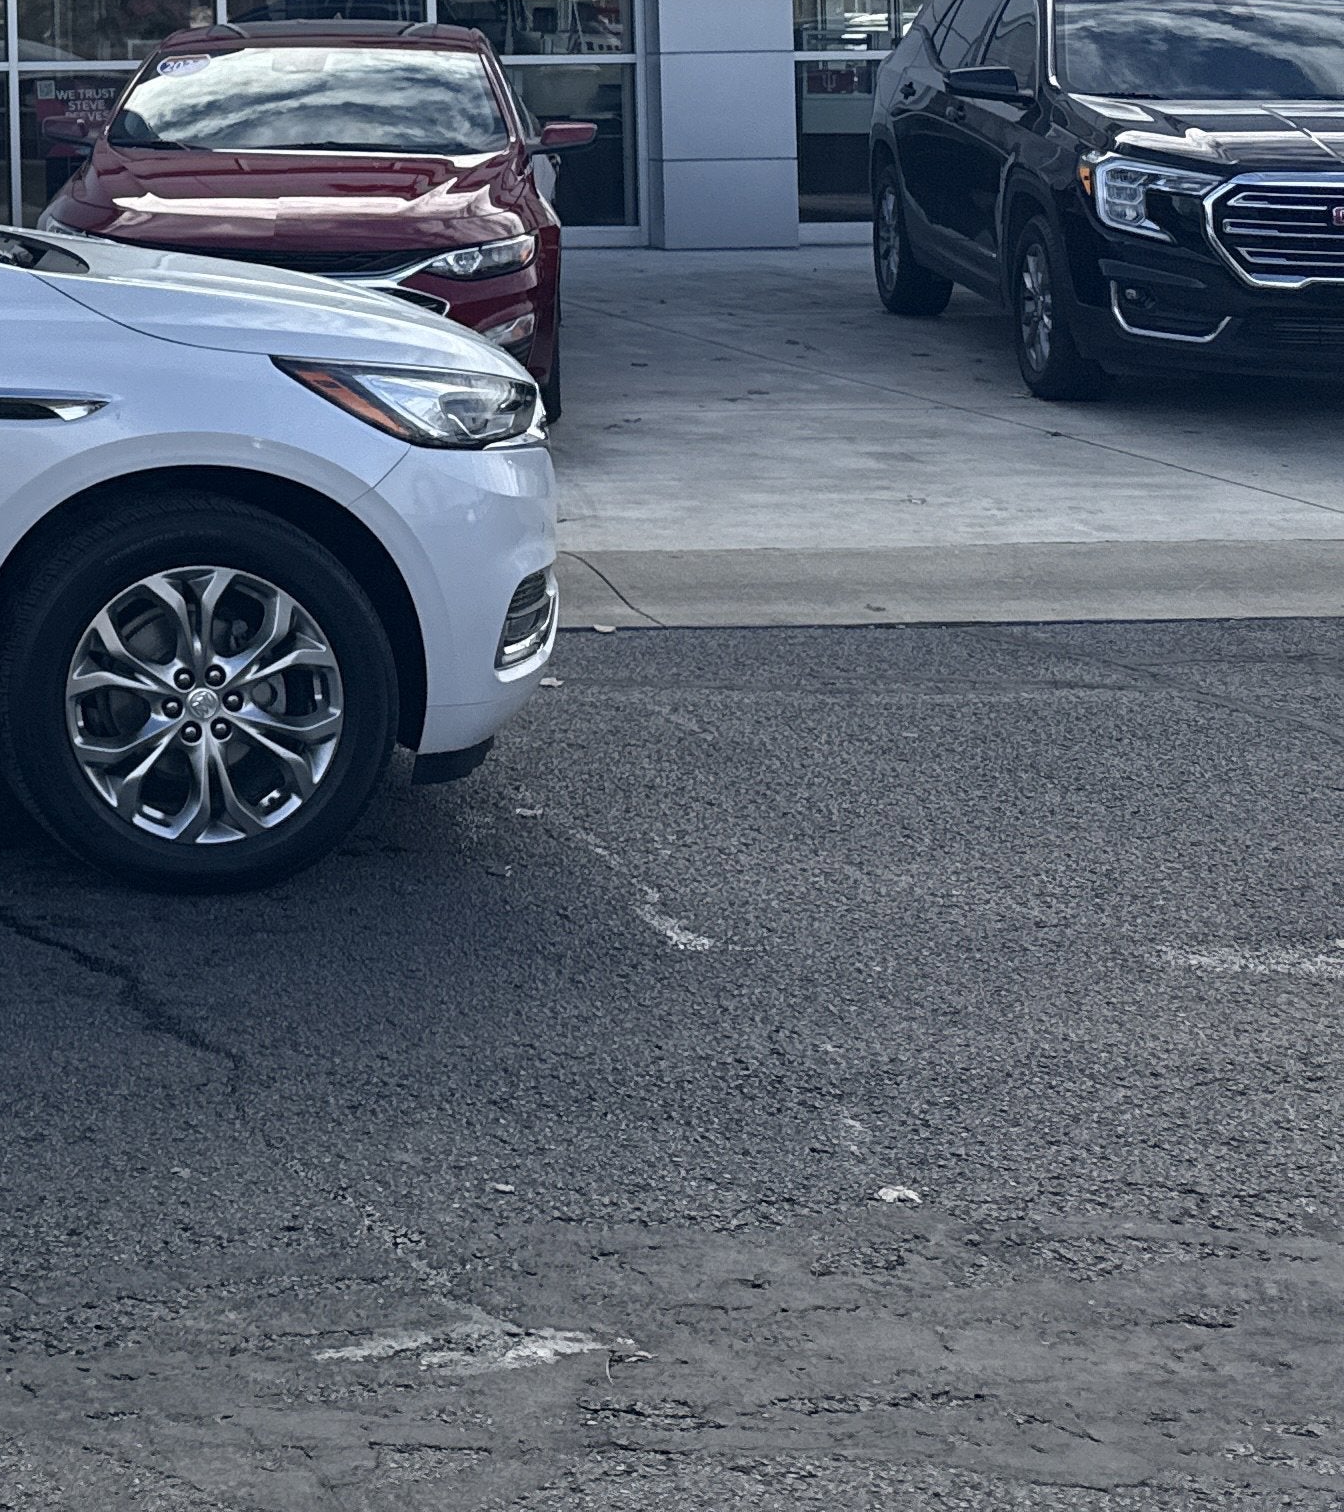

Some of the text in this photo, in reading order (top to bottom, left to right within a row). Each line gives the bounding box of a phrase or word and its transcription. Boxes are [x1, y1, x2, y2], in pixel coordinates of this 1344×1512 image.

[55, 87, 116, 100] WE TRUST
[68, 99, 106, 111] STEVE
